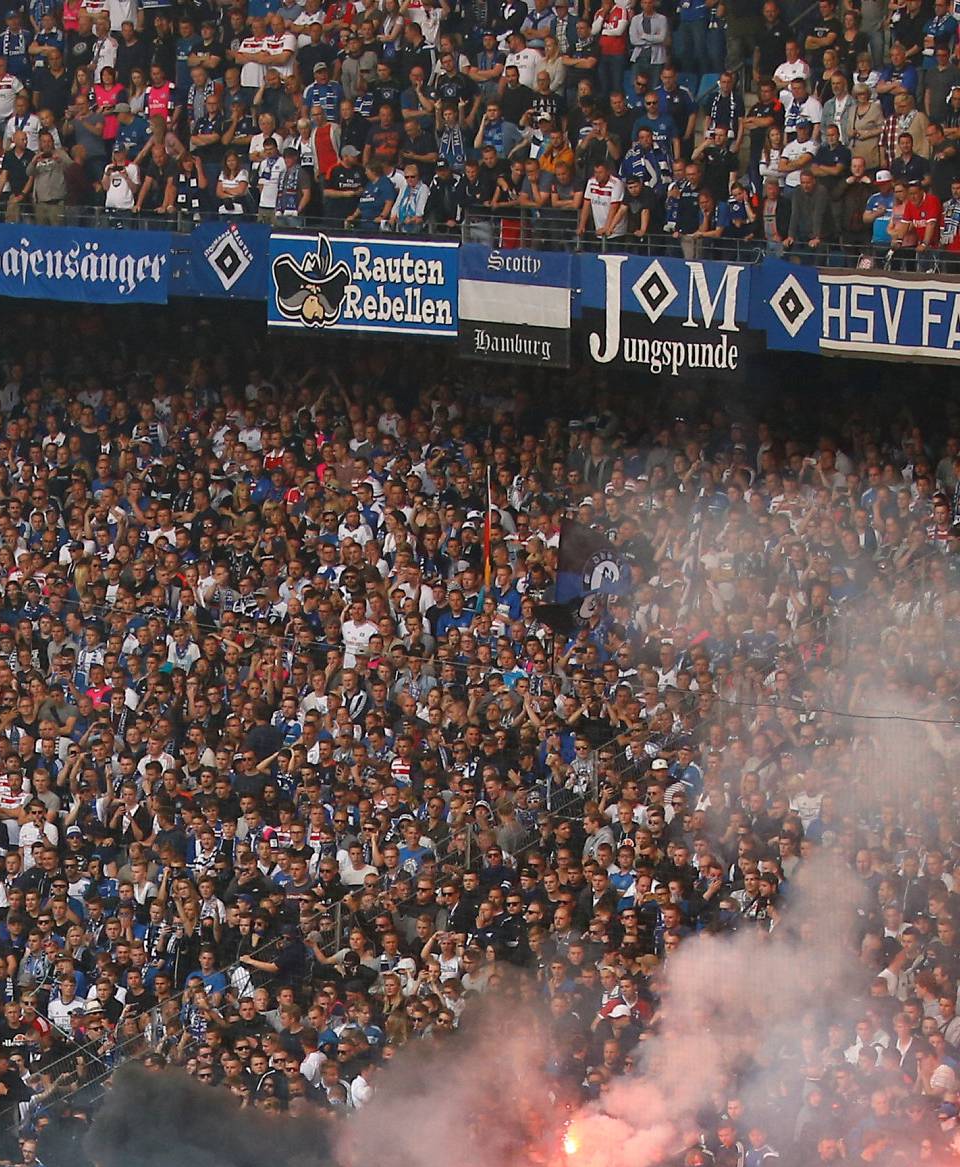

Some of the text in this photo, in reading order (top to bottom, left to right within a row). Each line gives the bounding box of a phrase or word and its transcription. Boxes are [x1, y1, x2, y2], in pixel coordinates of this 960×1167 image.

[351, 246, 445, 285] Rauten
[487, 250, 541, 276] Scotty
[343, 285, 454, 325] Rebellen
[823, 284, 906, 345] HSV
[474, 328, 552, 361] Hamburg
